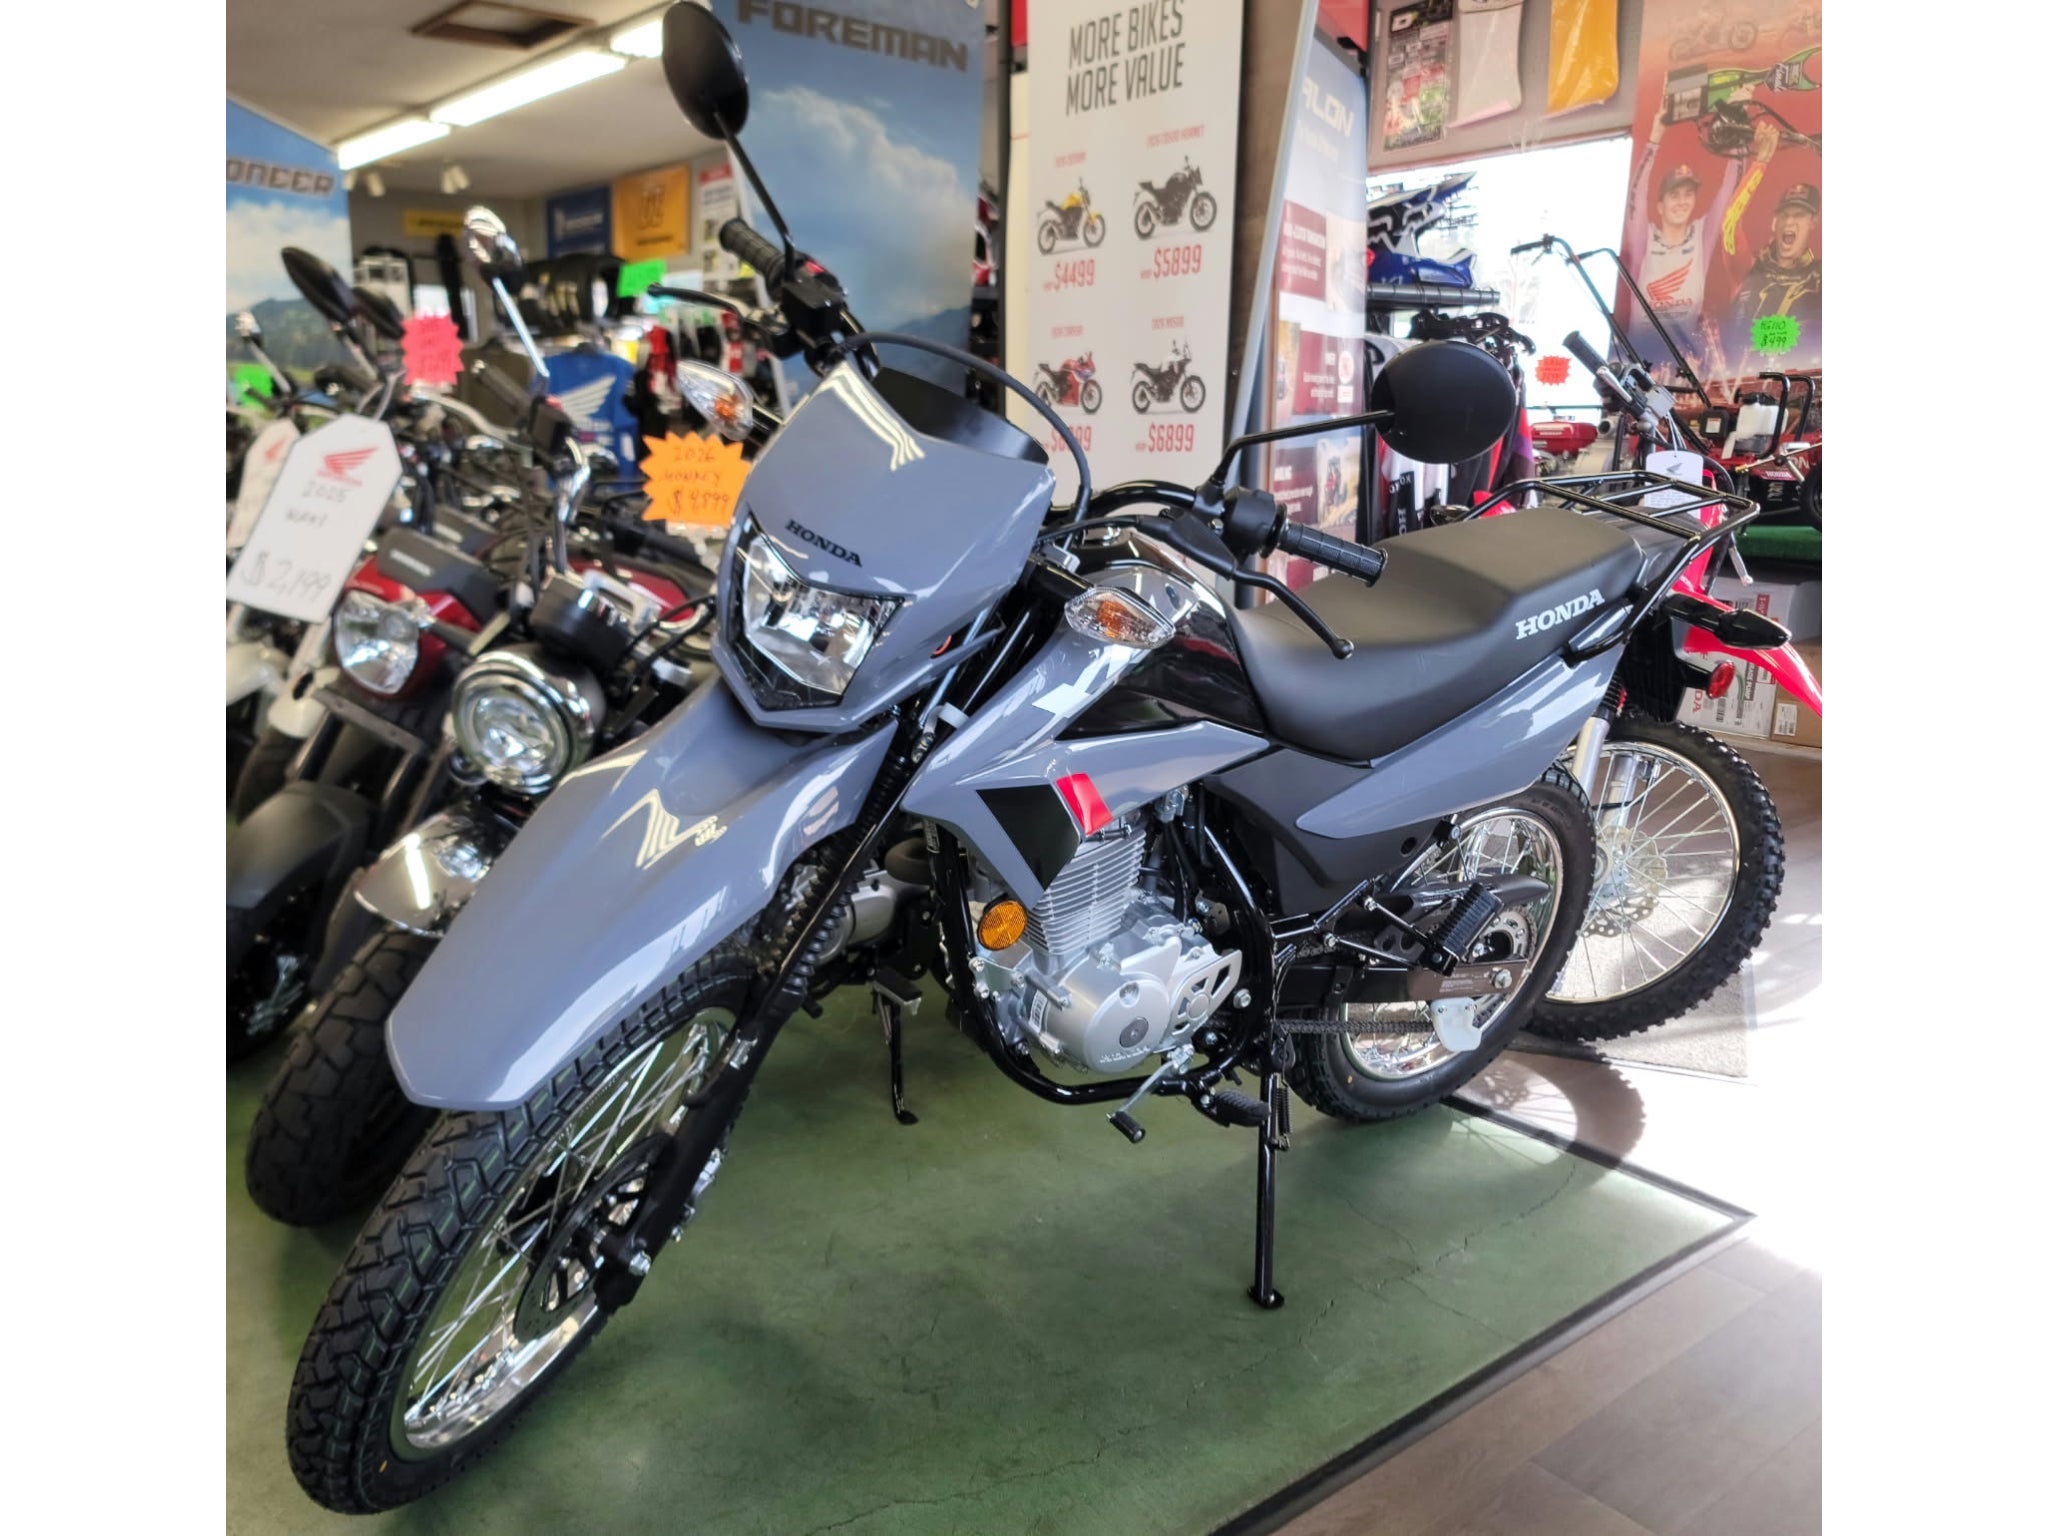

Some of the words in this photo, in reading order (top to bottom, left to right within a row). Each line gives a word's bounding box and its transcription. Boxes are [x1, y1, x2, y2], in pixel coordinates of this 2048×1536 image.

[738, 0, 969, 72] FOREMAN
[1069, 13, 1122, 70] MORE
[1128, 0, 1184, 52] BIKES
[1066, 62, 1119, 117] MORE
[1124, 42, 1186, 101] VALUE
[1054, 258, 1096, 290] $4499
[1153, 244, 1203, 281] $5899
[1050, 424, 1094, 454] $699
[1147, 421, 1196, 455] $6899
[785, 519, 863, 568] HONDA
[1515, 588, 1606, 640] HONDA
